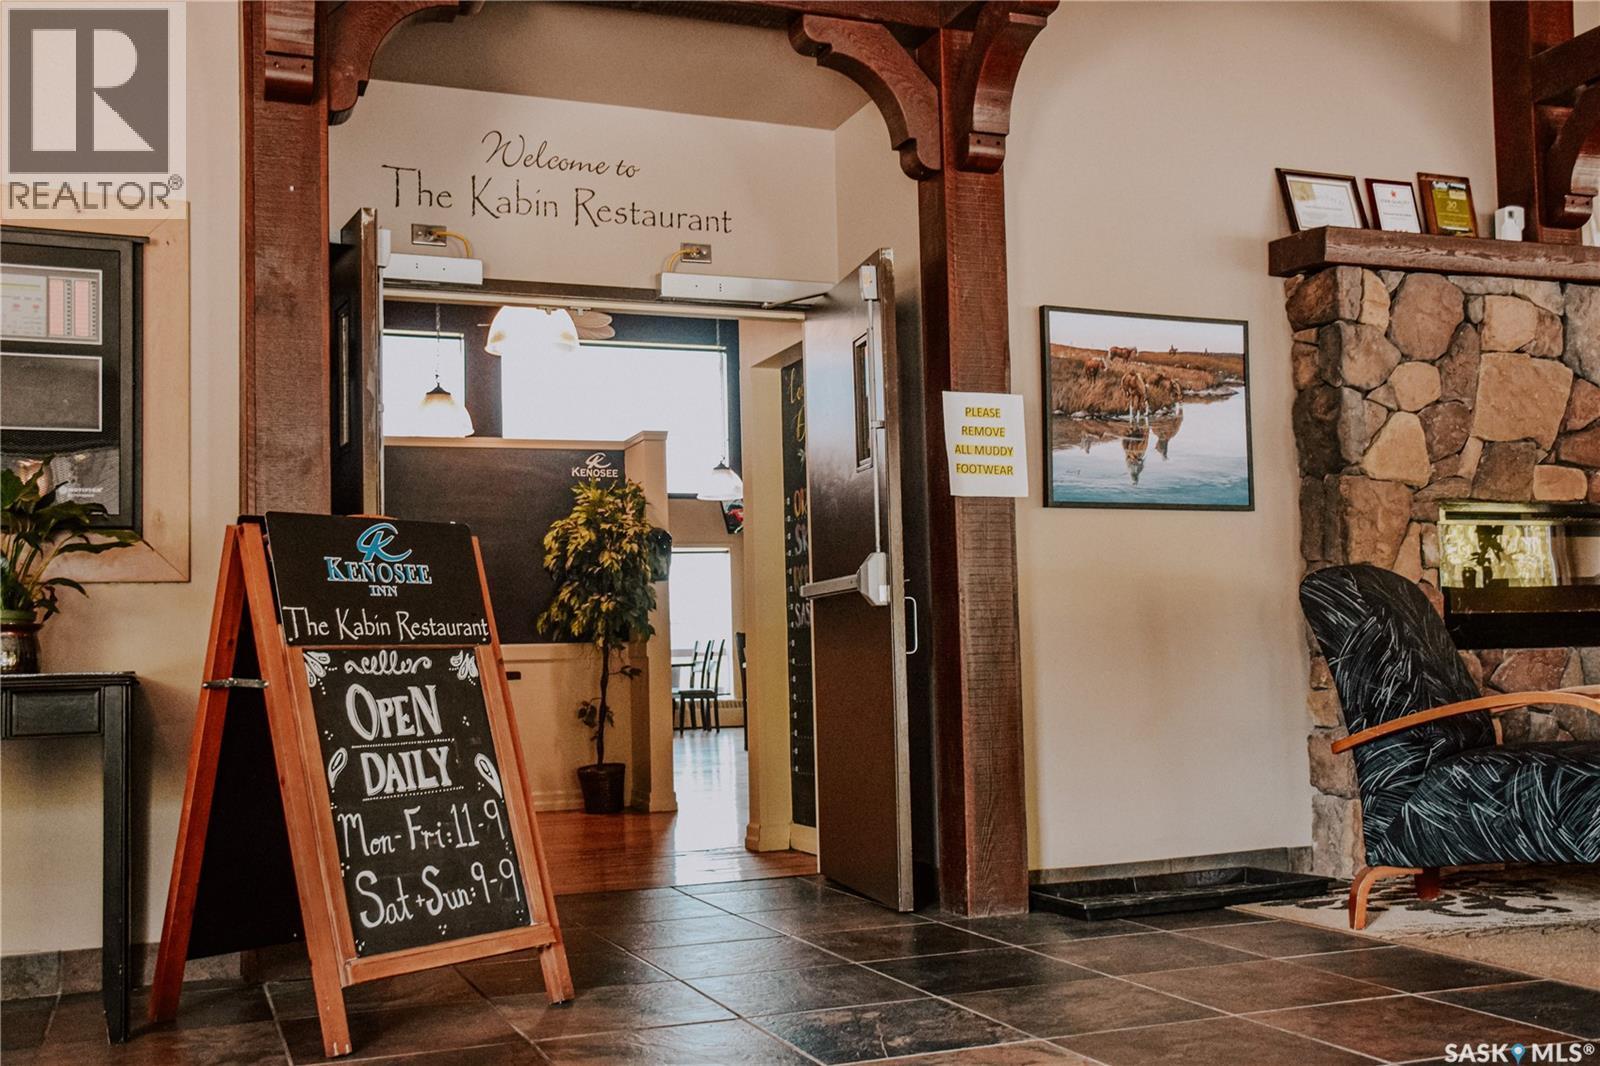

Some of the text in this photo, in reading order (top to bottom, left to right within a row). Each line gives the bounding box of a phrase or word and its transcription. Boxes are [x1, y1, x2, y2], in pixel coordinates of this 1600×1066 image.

[481, 129, 641, 179] Welcome to
[381, 164, 734, 234] The Kabin Restaurant
[965, 407, 1000, 418] PLEASE
[961, 425, 1006, 437] REMOVE
[954, 444, 1014, 457] ALL MUDDY
[571, 466, 619, 478] KENOSEE
[956, 463, 1013, 475] FOOTWEAR
[323, 556, 433, 585] KENOSEE
[368, 585, 398, 597] INN
[282, 606, 489, 641] The Kabin Restaurant
[345, 683, 443, 741] OPEN
[359, 746, 453, 797] DAILY
